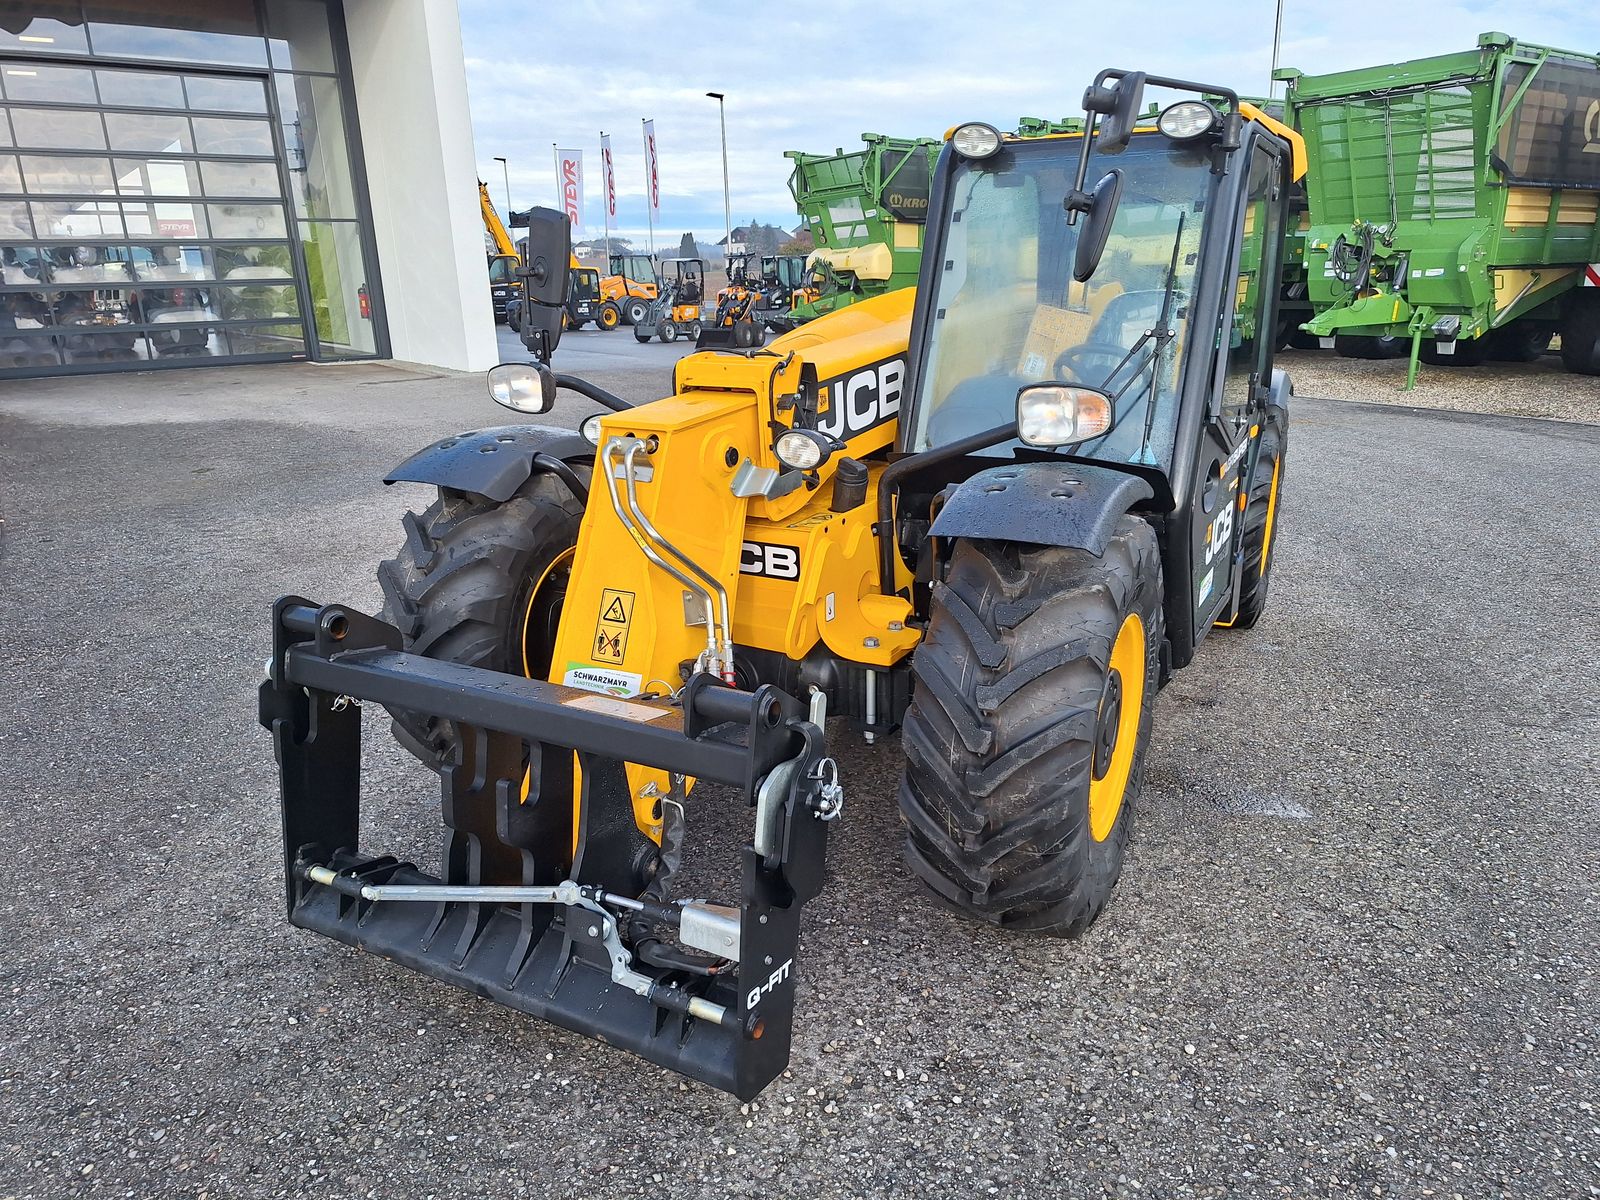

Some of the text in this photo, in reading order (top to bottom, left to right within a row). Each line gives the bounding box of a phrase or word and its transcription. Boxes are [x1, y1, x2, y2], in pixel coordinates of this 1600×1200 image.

[562, 159, 578, 226] STEYR
[160, 223, 190, 231] STEYR
[817, 359, 905, 443] JCB
[1205, 499, 1234, 566] JCB
[573, 671, 628, 688] SCHWARZMAYR
[573, 679, 605, 689] LANDTECHNIK
[746, 957, 793, 1010] Q-FIT
